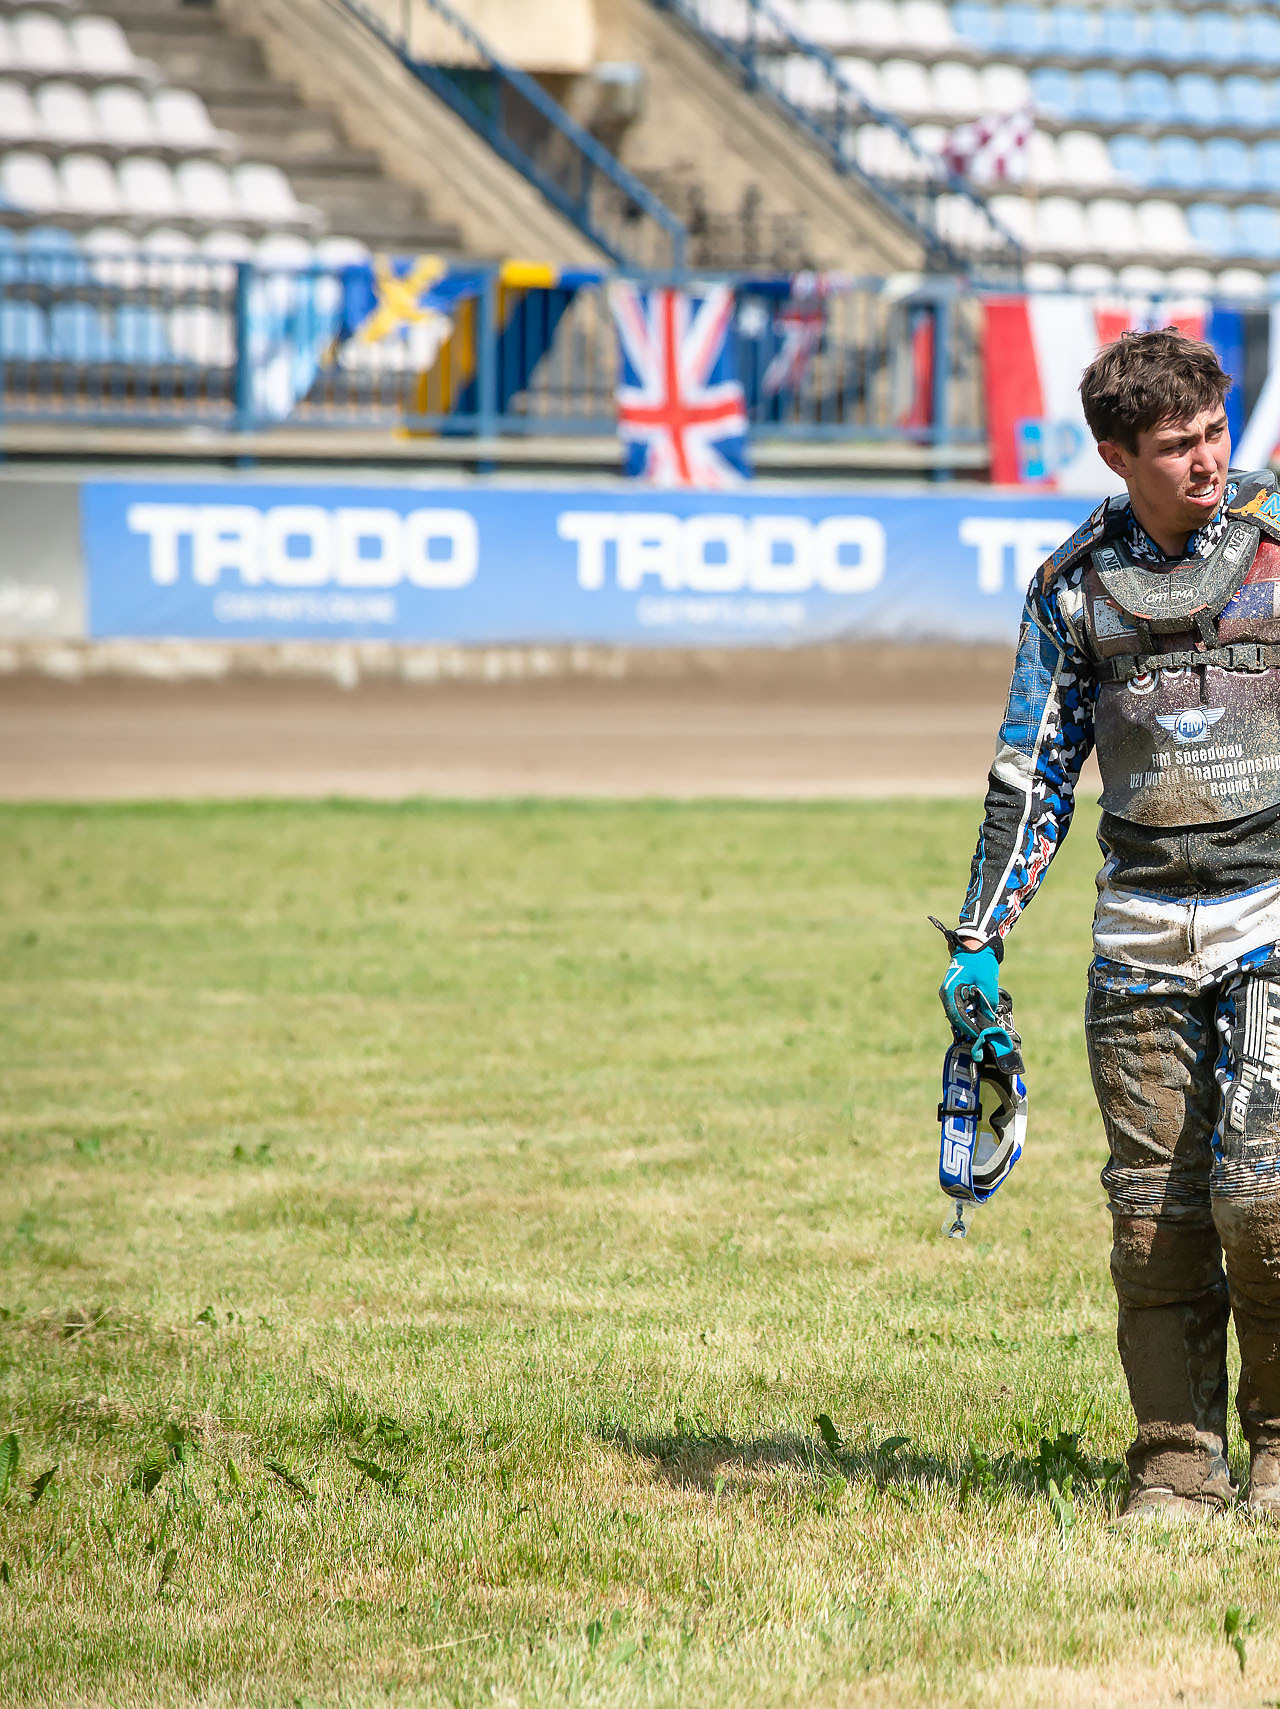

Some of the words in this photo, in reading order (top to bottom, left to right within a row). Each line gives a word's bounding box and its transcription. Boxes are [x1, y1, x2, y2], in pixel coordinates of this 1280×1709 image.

[127, 502, 478, 589] TRODO
[556, 510, 886, 593] TRODO
[1145, 588, 1195, 603] ORTEMA
[1175, 743, 1243, 765] Speedway
[1210, 779, 1250, 797] Round
